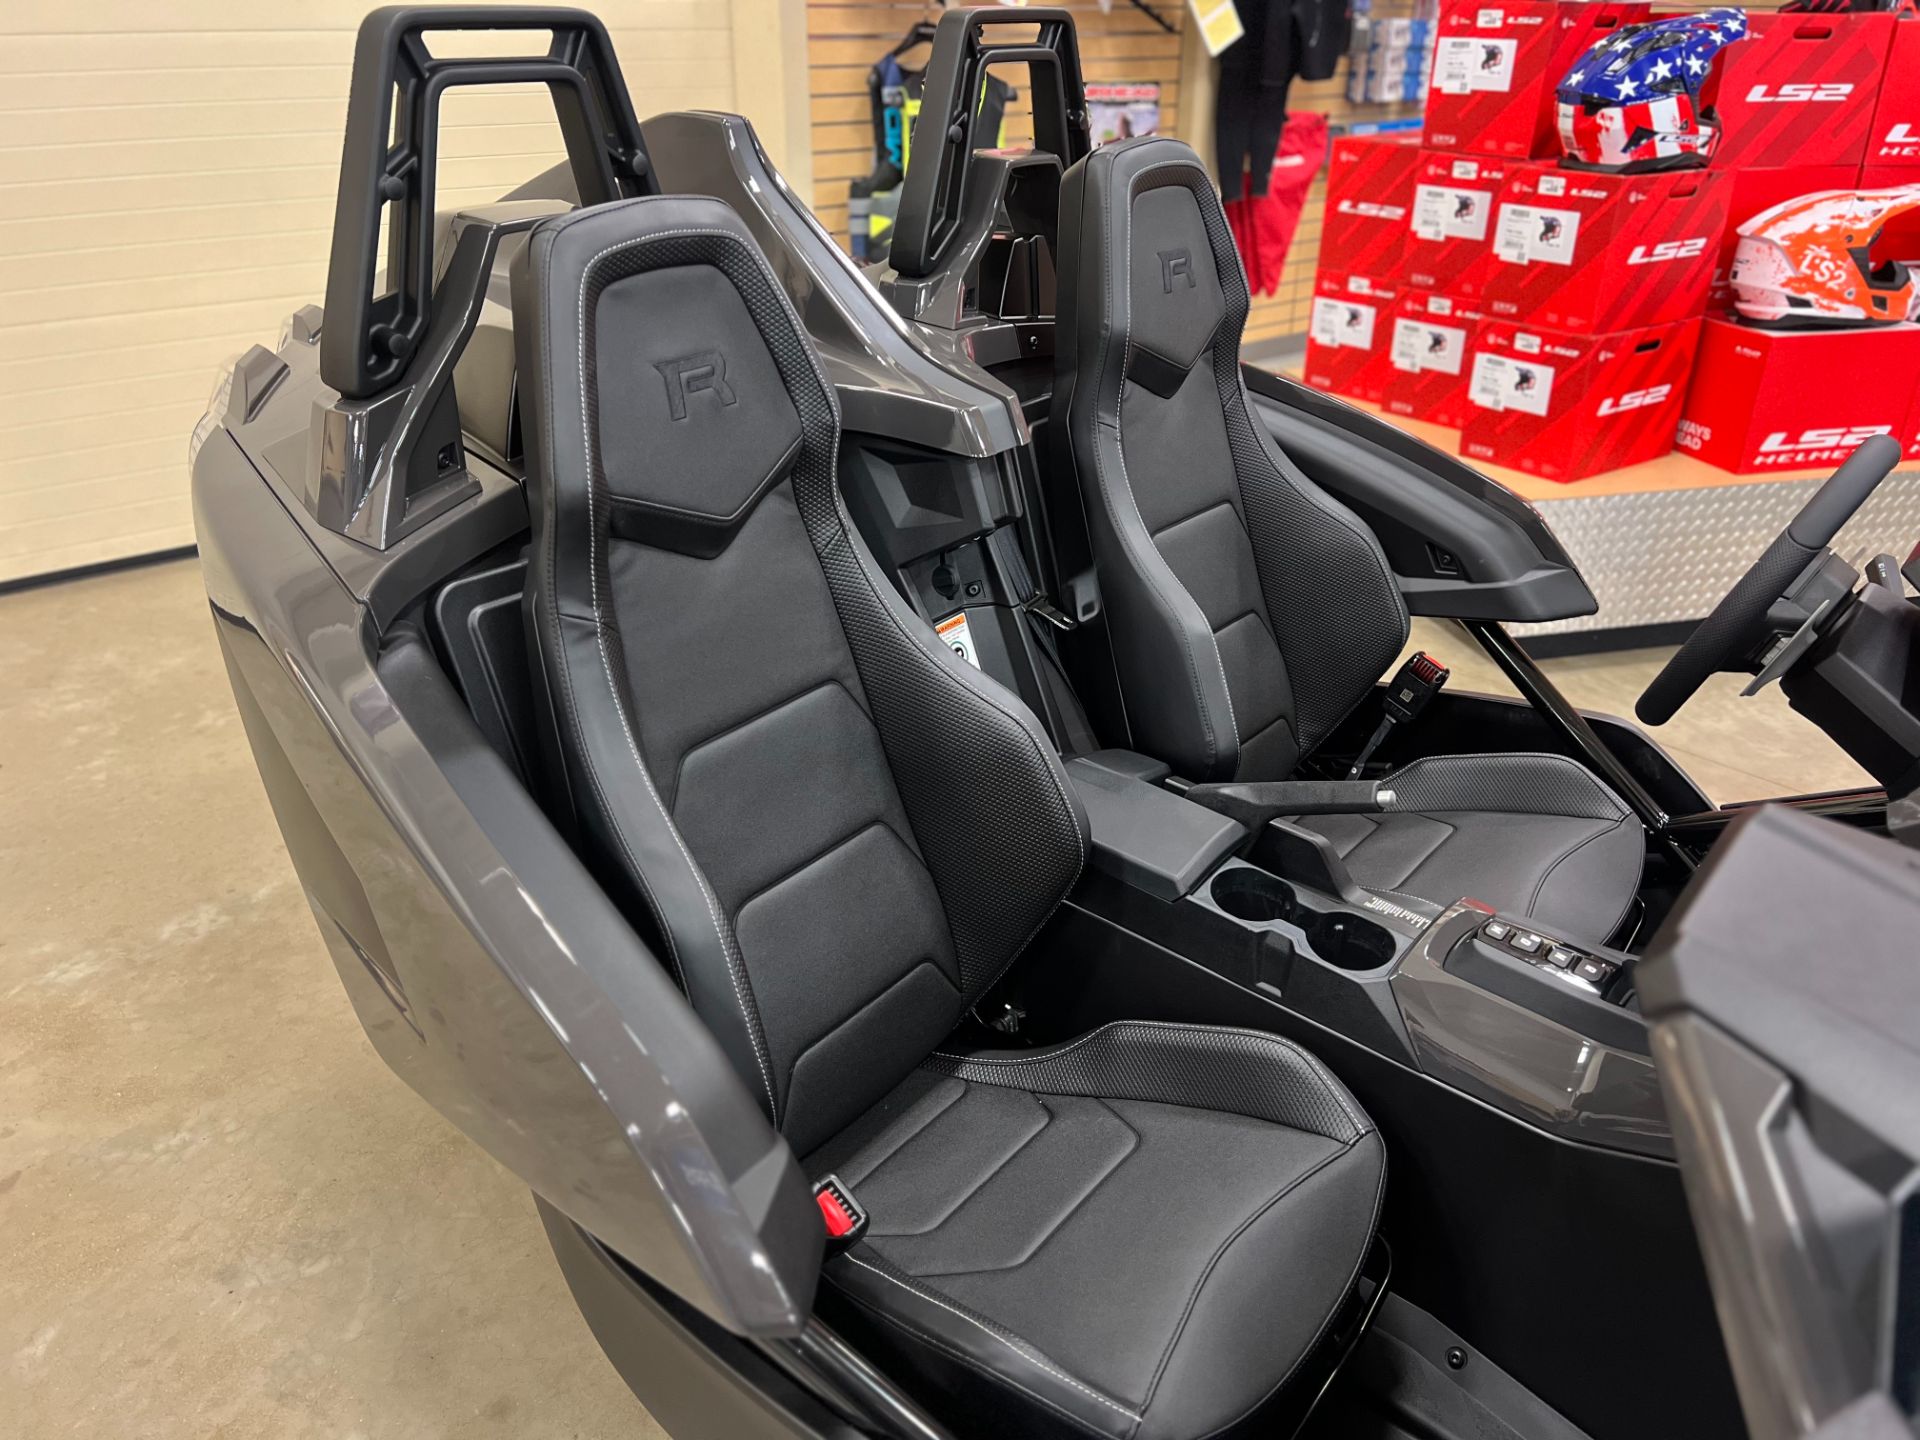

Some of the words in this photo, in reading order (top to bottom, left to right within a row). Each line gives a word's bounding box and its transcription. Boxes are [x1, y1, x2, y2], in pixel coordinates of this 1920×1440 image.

[1745, 83, 1855, 103] LS2
[1338, 200, 1406, 221] LS2
[1627, 237, 1708, 265] LS2
[1156, 246, 1197, 295] R
[652, 349, 738, 422] R
[1597, 384, 1672, 417] LS2
[1759, 424, 1893, 453] LS2
[1753, 449, 1857, 466] HELME
